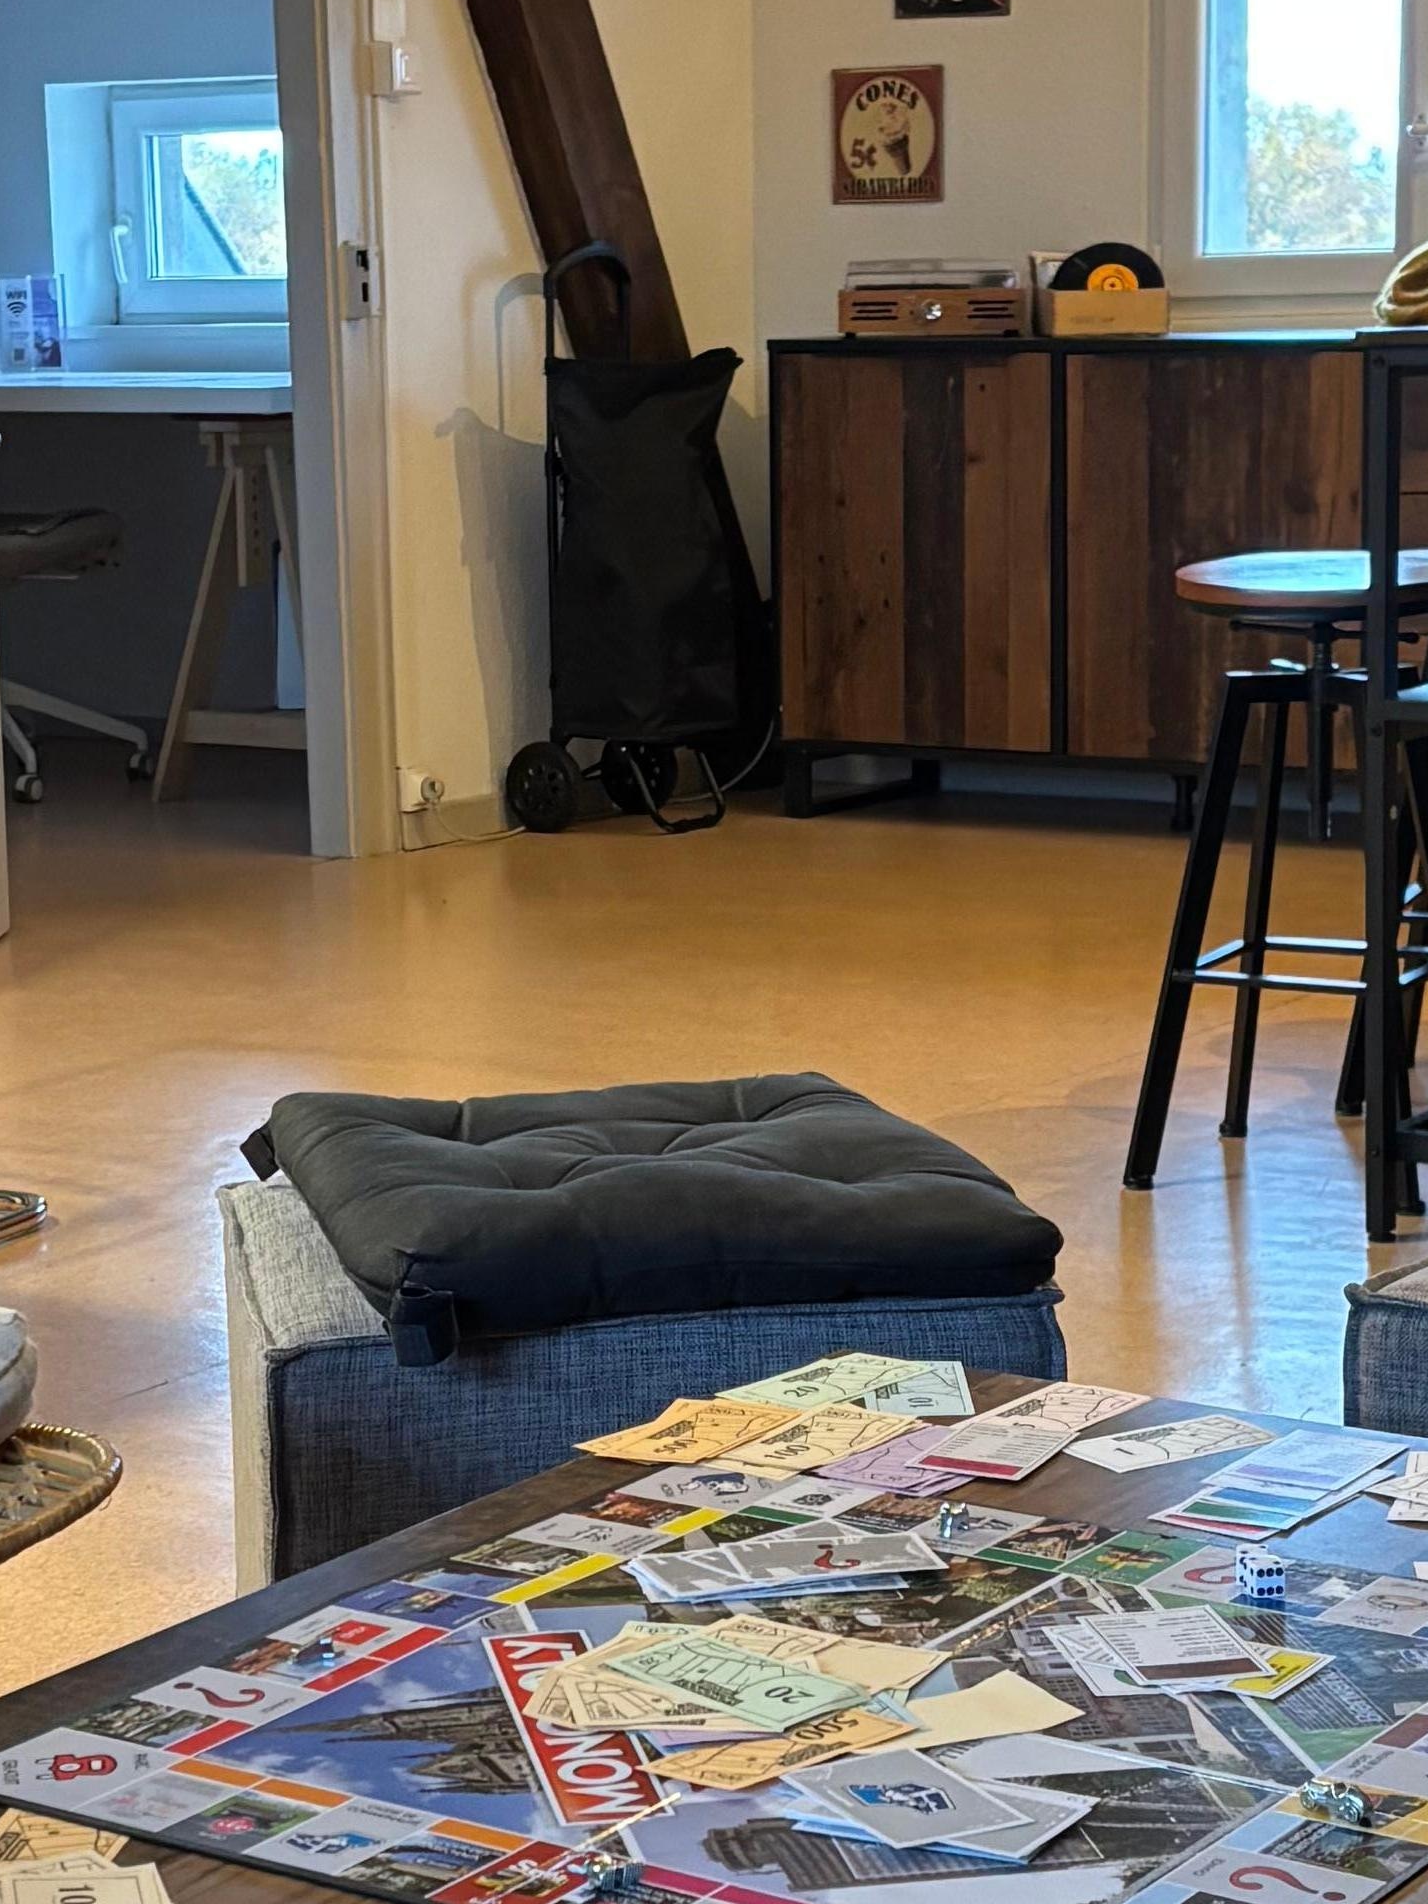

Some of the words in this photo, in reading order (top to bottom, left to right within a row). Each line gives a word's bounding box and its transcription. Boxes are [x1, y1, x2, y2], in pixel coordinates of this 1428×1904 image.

[855, 80, 918, 112] CONES
[784, 1384, 820, 1398] 20
[765, 1443, 811, 1460] 100
[764, 1685, 809, 1705] 20
[794, 1714, 860, 1741] 500
